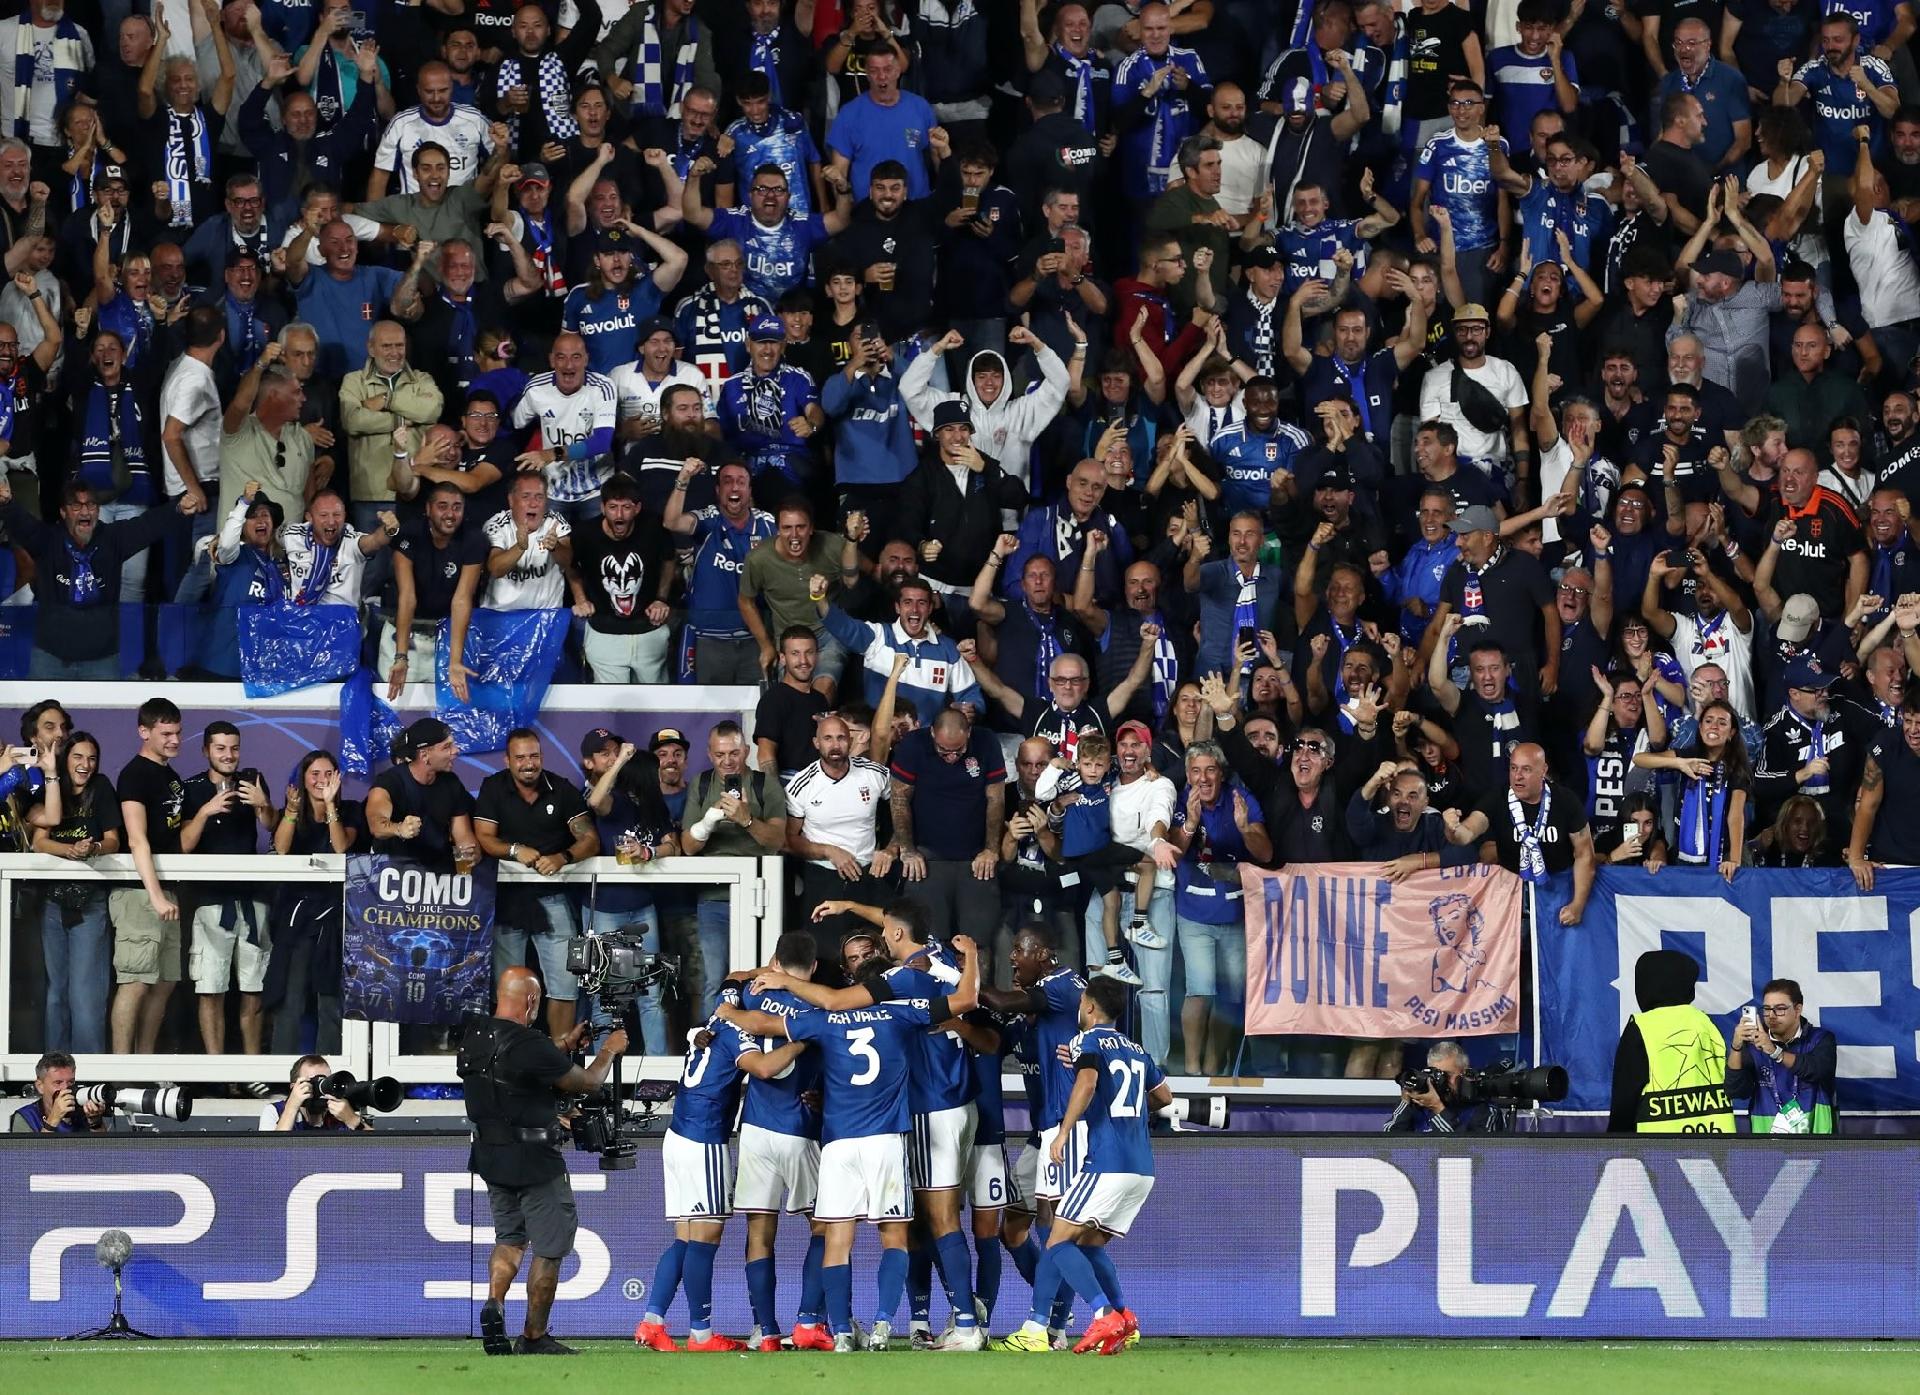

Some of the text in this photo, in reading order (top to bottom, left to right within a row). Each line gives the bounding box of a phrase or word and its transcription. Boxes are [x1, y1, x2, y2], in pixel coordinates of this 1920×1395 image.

[476, 14, 514, 27] Revol
[1817, 100, 1871, 121] Revolut
[449, 156, 467, 171] er
[1443, 173, 1491, 194] Uber
[749, 253, 794, 277] Uber
[580, 313, 636, 335] Revolut
[1226, 466, 1273, 482] Revolu
[379, 867, 473, 906] COMO
[363, 907, 481, 931] CHAMPIONS
[405, 904, 444, 914] SI DICE
[1263, 876, 1392, 1008] DONNE
[408, 971, 426, 981] COMO
[1610, 893, 1920, 1078] PE
[405, 981, 426, 1003] 10
[1404, 994, 1516, 1030] PESI MASSIMI
[846, 1026, 881, 1087] 3
[1108, 1059, 1145, 1118] 27
[1649, 1088, 1733, 1117] STEWAR
[989, 1177, 1003, 1201] 6
[30, 1172, 612, 1301] PS5
[1301, 1157, 1823, 1318] PLAY
